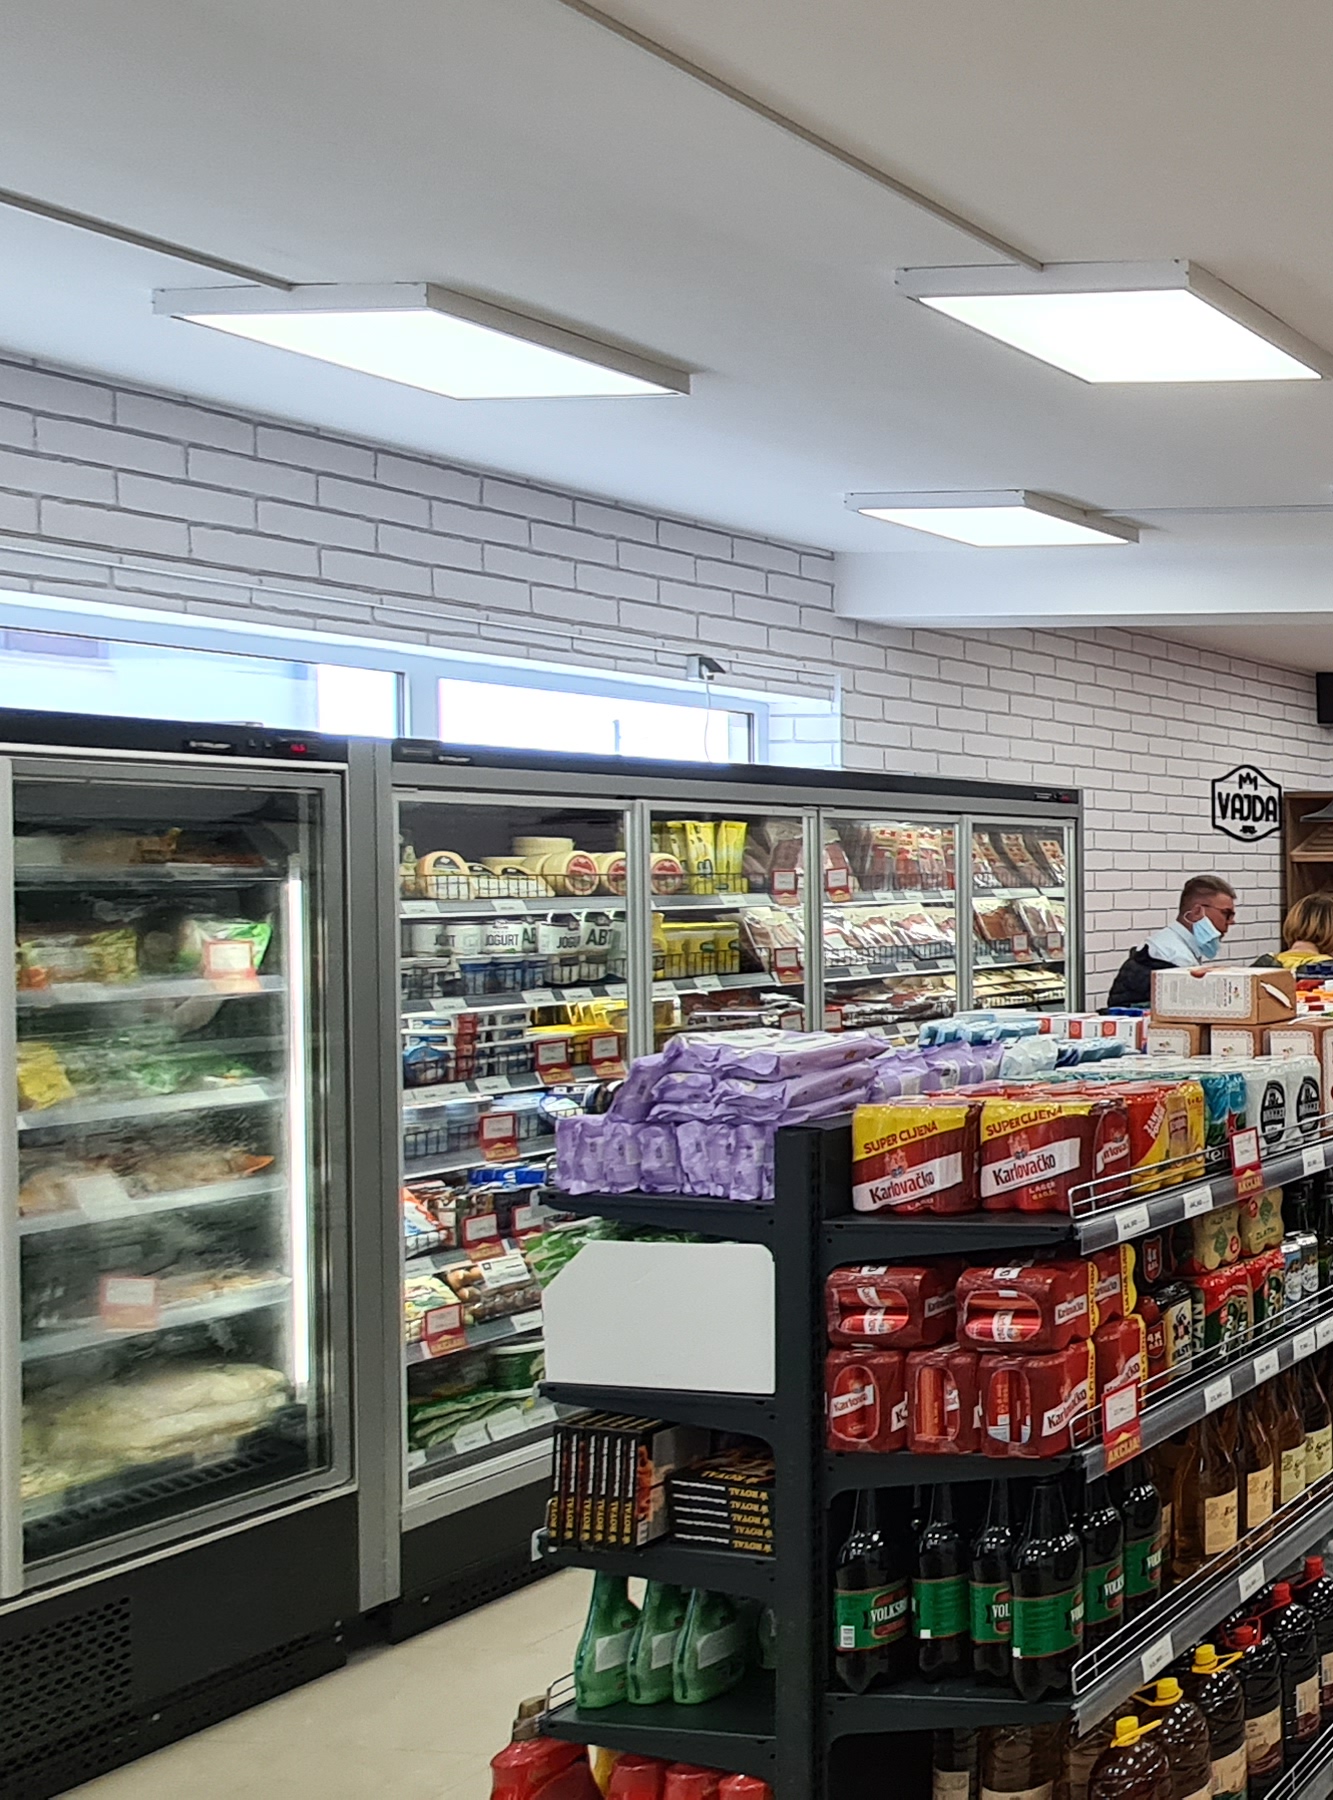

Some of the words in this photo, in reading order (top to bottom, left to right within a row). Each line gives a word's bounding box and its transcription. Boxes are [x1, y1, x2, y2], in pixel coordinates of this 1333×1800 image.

[1217, 791, 1278, 823] VAJDA
[484, 933, 519, 947] JOGURT
[522, 927, 537, 945] AB
[556, 935, 581, 949] JOGU
[985, 1118, 1019, 1137] SUPER
[1019, 1106, 1064, 1128] CIJENA
[863, 1134, 898, 1155] SUPER
[898, 1121, 939, 1144] CIJENA
[992, 1152, 1057, 1186] Karlovačko
[868, 1170, 936, 1204] Karlovačko
